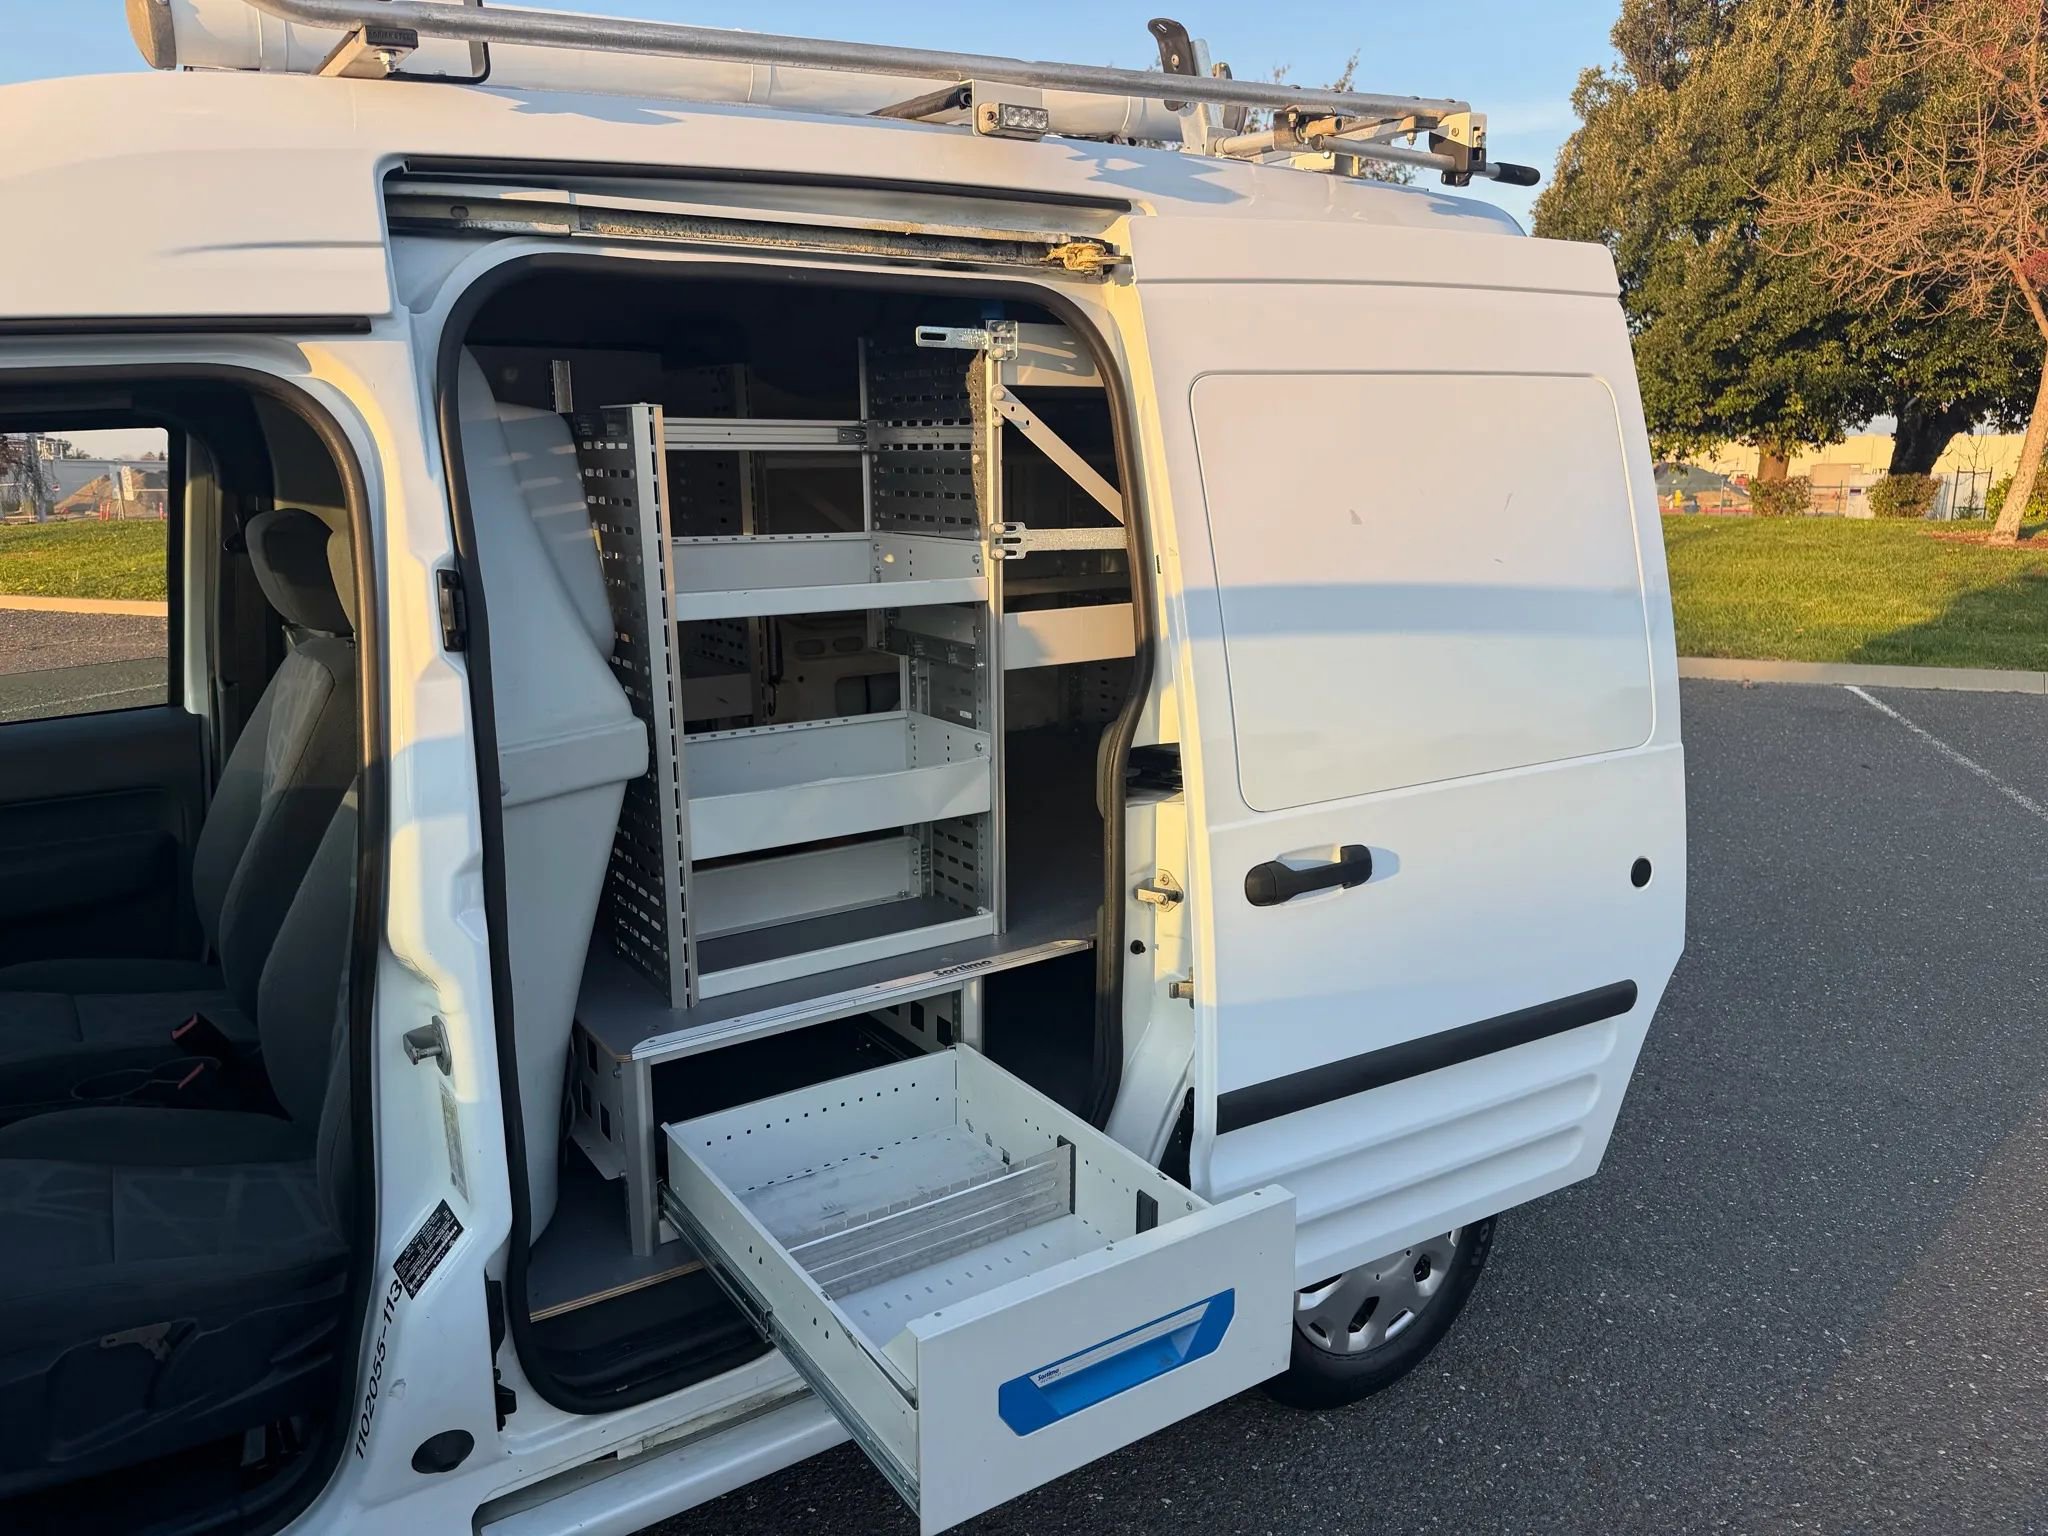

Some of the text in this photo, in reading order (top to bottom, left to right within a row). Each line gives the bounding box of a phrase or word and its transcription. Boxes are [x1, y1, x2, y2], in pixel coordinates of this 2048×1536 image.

[933, 960, 993, 977] Sortimo
[355, 1278, 403, 1460] 1102055-113
[1037, 1368, 1060, 1382] Sortimo
